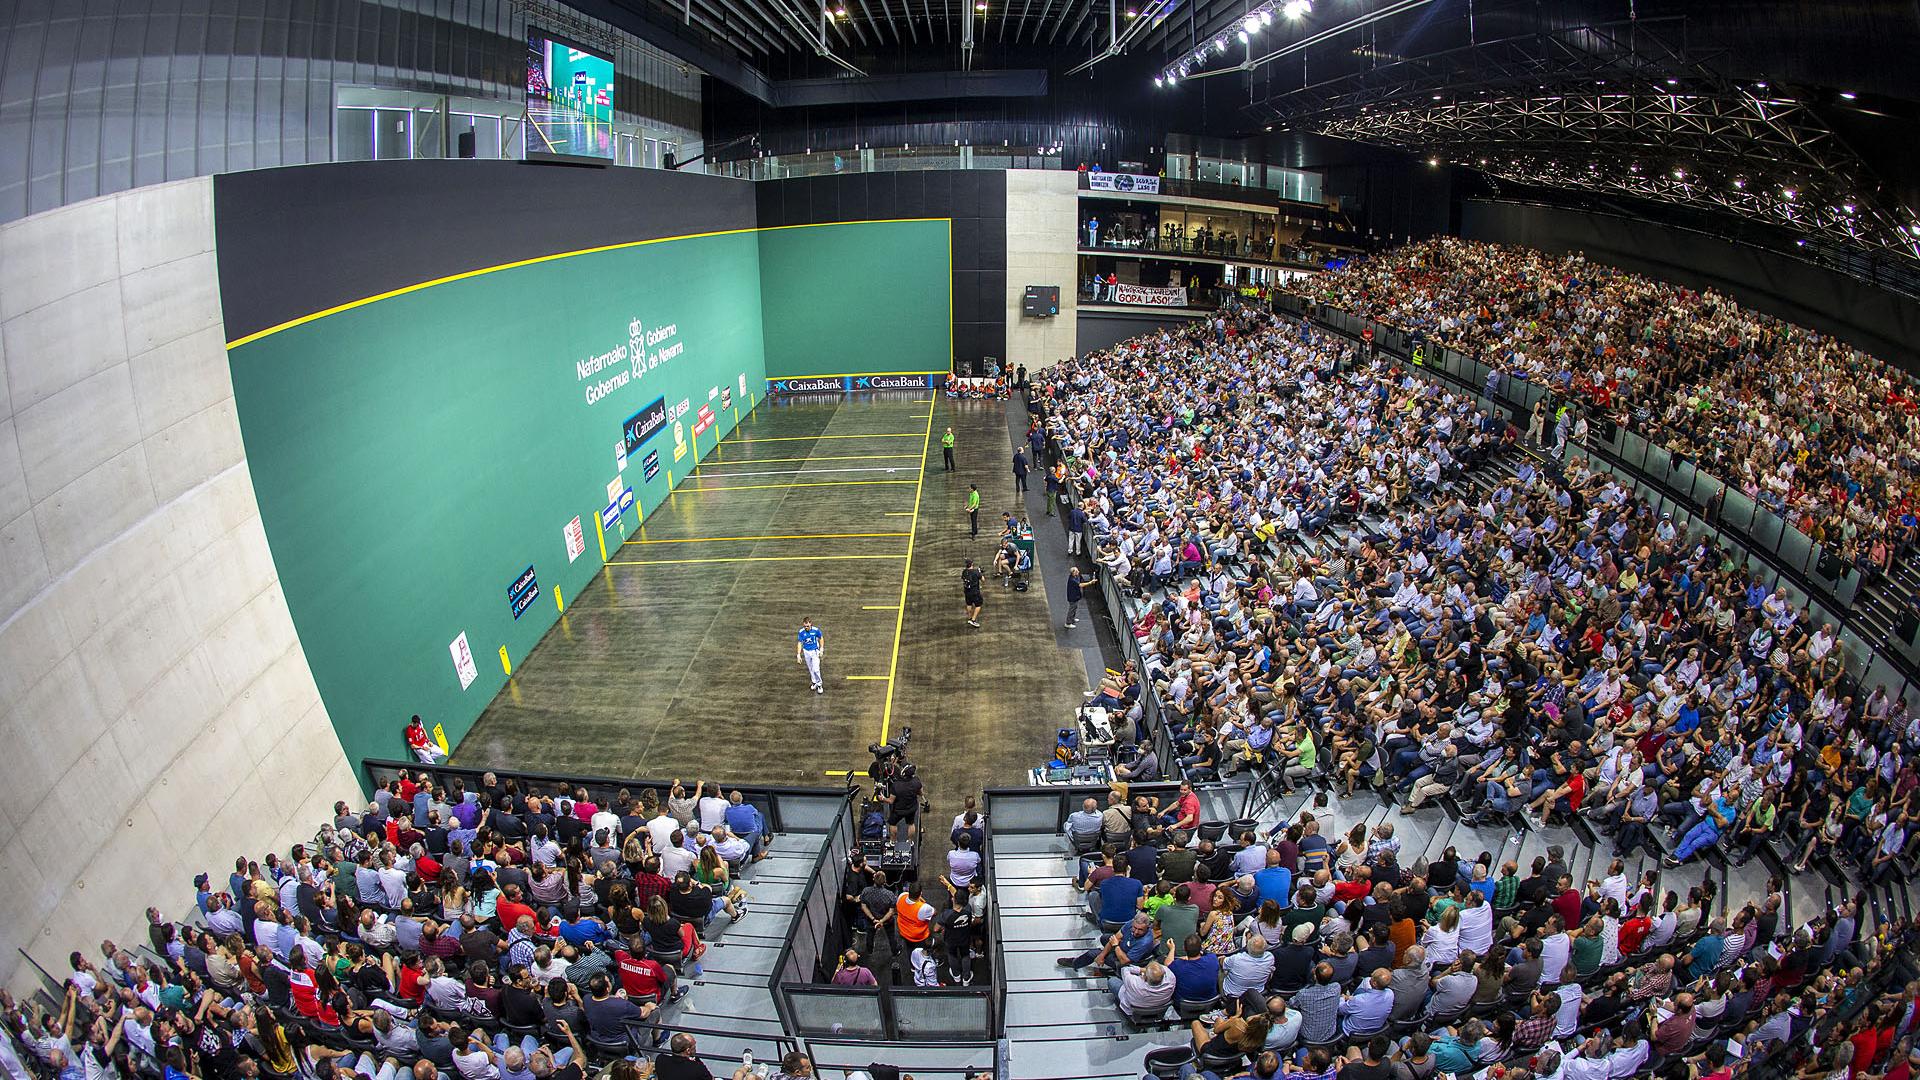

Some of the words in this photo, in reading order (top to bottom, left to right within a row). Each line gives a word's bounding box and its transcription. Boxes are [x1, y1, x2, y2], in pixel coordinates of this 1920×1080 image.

[1119, 293, 1143, 304] GORA
[646, 323, 677, 347] Gobierno
[576, 343, 627, 380] Nafarroako
[648, 353, 658, 370] de
[658, 341, 684, 366] Navarra
[585, 369, 630, 406] Gobernua
[788, 380, 842, 392] CaixaBank
[871, 376, 925, 388] CaixaBank
[635, 405, 666, 439] CaixaBank
